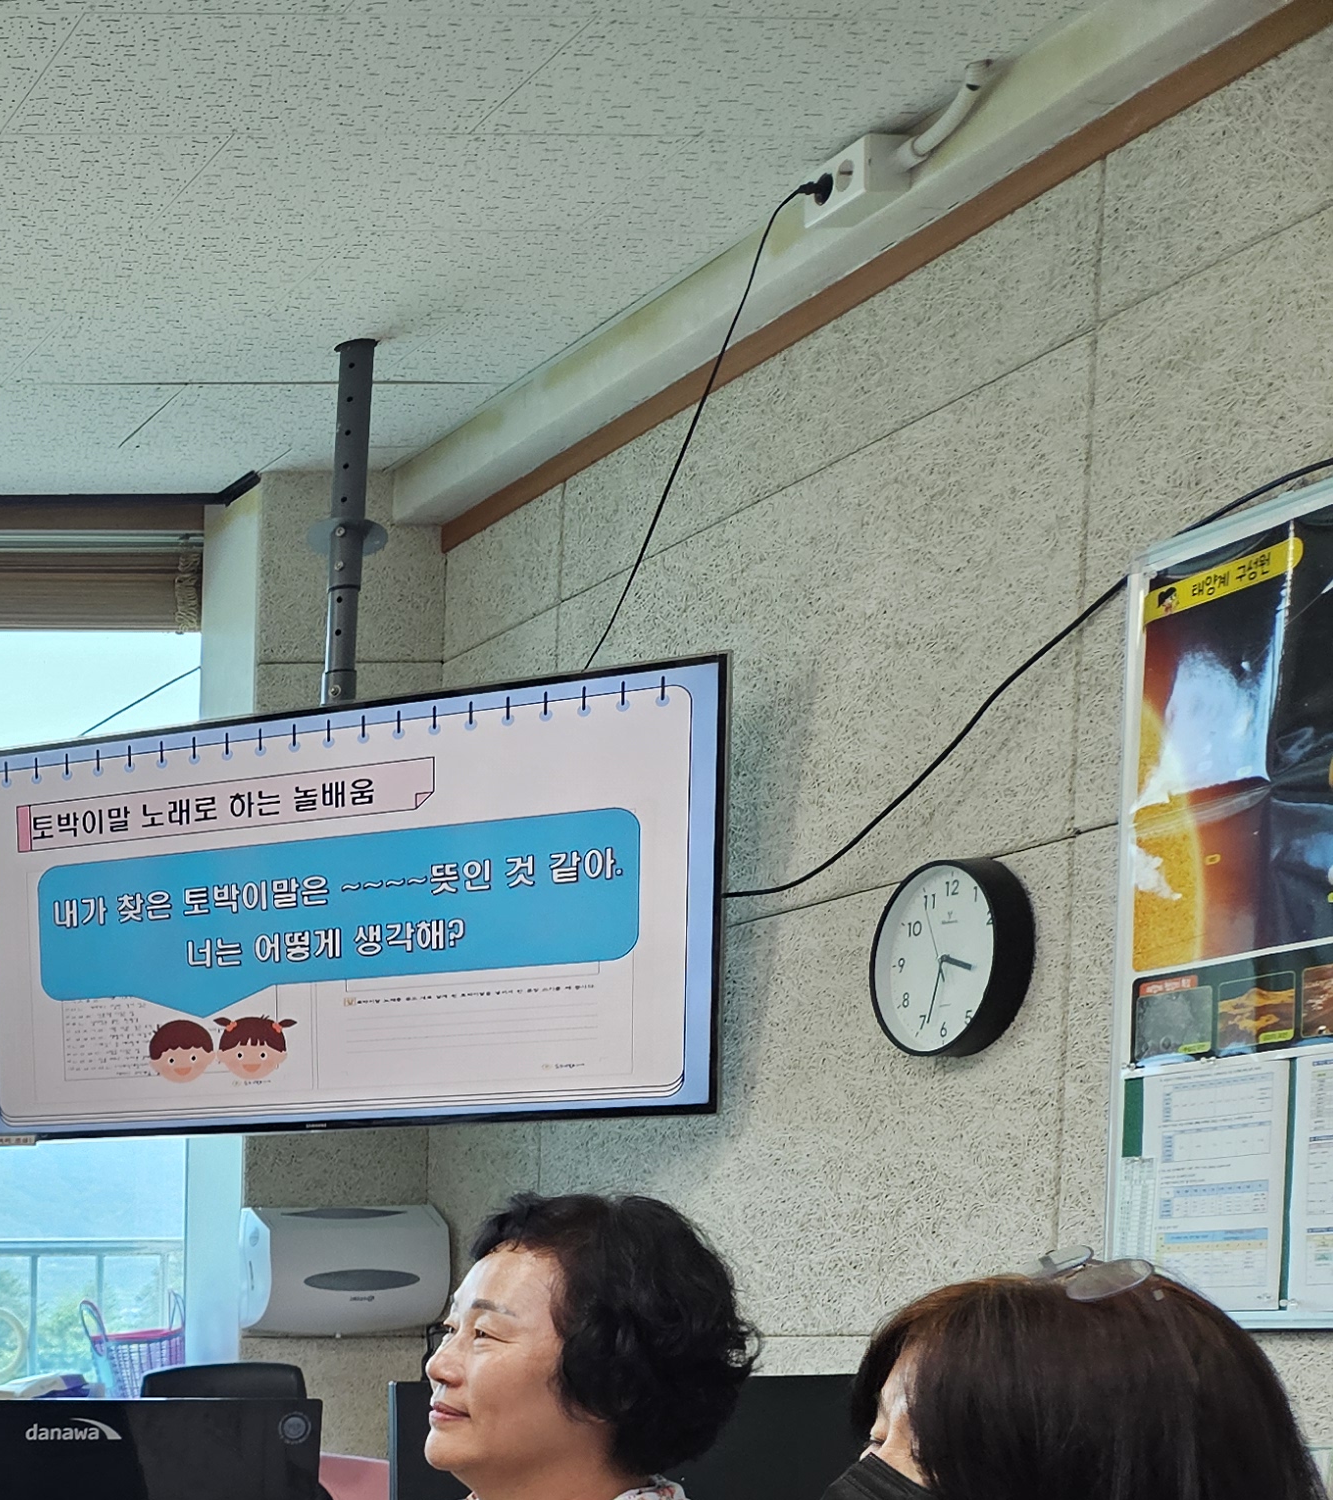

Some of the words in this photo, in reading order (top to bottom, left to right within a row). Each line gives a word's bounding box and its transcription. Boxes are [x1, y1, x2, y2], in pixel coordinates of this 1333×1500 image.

[1192, 571, 1229, 597] 태양계
[1235, 552, 1271, 582] 구성원
[32, 805, 131, 842] 토박이말
[140, 796, 217, 830] 노래로
[228, 791, 280, 820] 하는
[292, 779, 376, 815] 놀배움
[53, 896, 107, 930] 내가
[116, 892, 173, 924] 찾은
[183, 876, 330, 919] 토박이말은
[506, 857, 536, 891] 것
[549, 845, 624, 886] 같아.
[946, 880, 959, 896] 12
[974, 886, 977, 902] 1
[924, 894, 936, 910] 11
[908, 921, 922, 936] 10
[187, 935, 242, 971] 너는
[253, 926, 342, 966] 어떻게
[353, 917, 466, 959] 생각해?
[898, 957, 905, 973] 9
[902, 992, 909, 1008] 8
[919, 1015, 926, 1029] 7
[940, 1022, 947, 1037] 6
[25, 1423, 101, 1441] danawa
